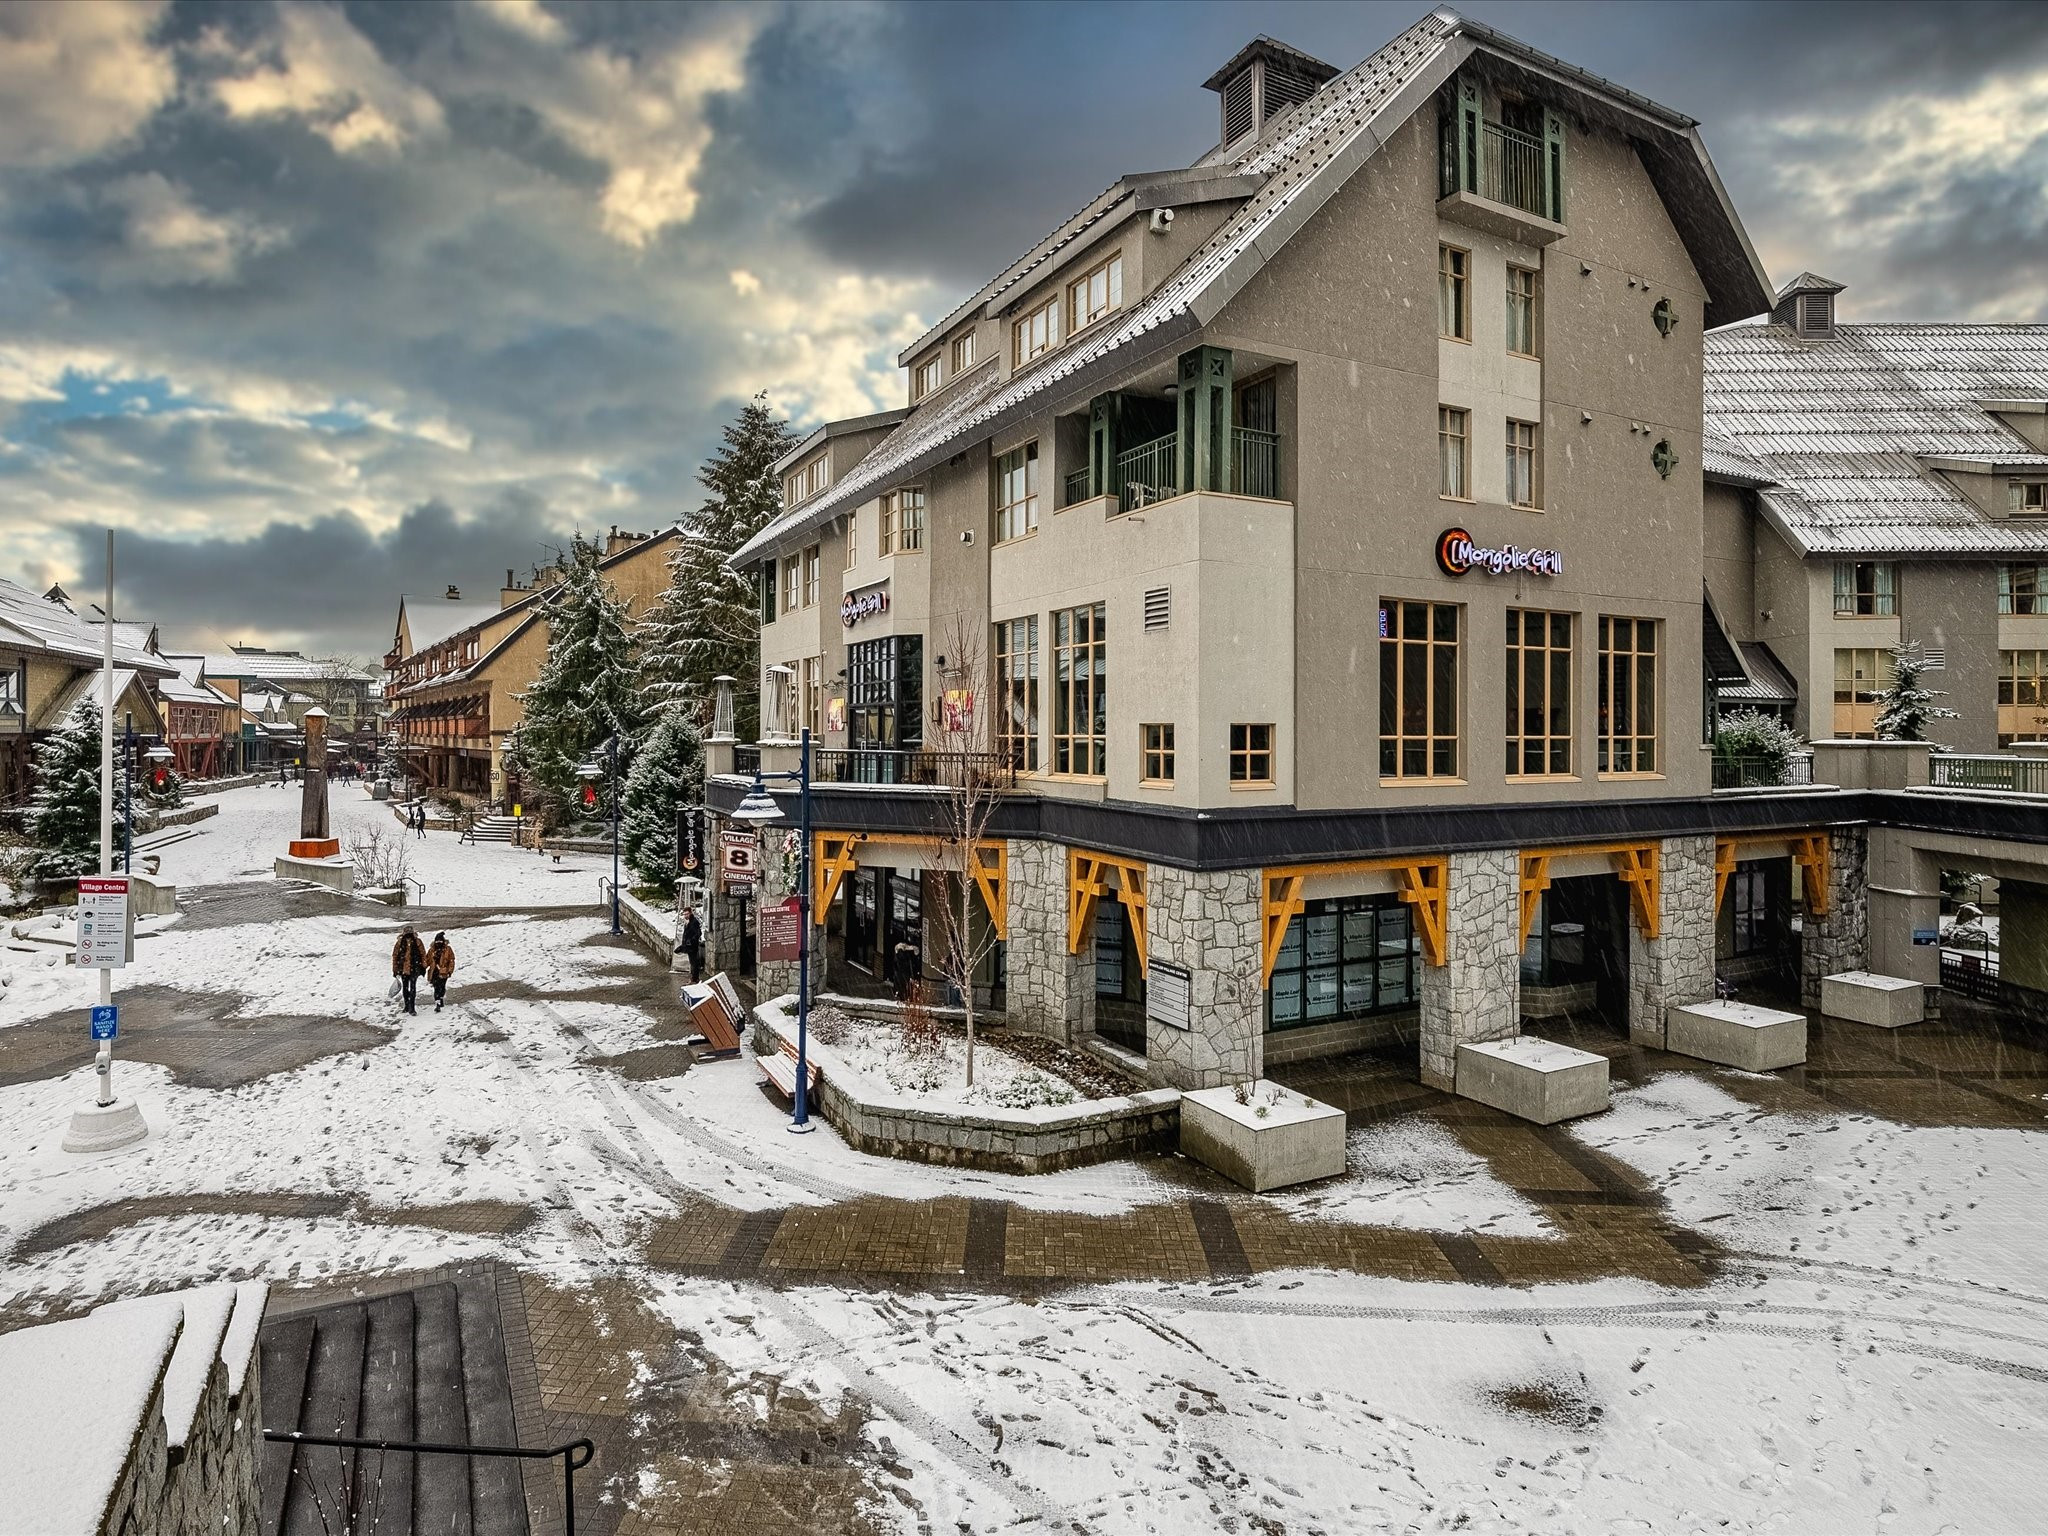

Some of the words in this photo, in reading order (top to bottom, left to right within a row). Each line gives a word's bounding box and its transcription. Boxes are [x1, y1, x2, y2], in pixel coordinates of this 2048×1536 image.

[1458, 540, 1529, 574] Mongolie
[1532, 549, 1562, 574] Grill
[684, 811, 696, 828] Grill
[685, 829, 697, 864] Mongolie
[724, 834, 754, 844] VILLAGE
[730, 849, 750, 867] 8
[724, 872, 756, 881] CINEMAS
[81, 884, 102, 892] Village
